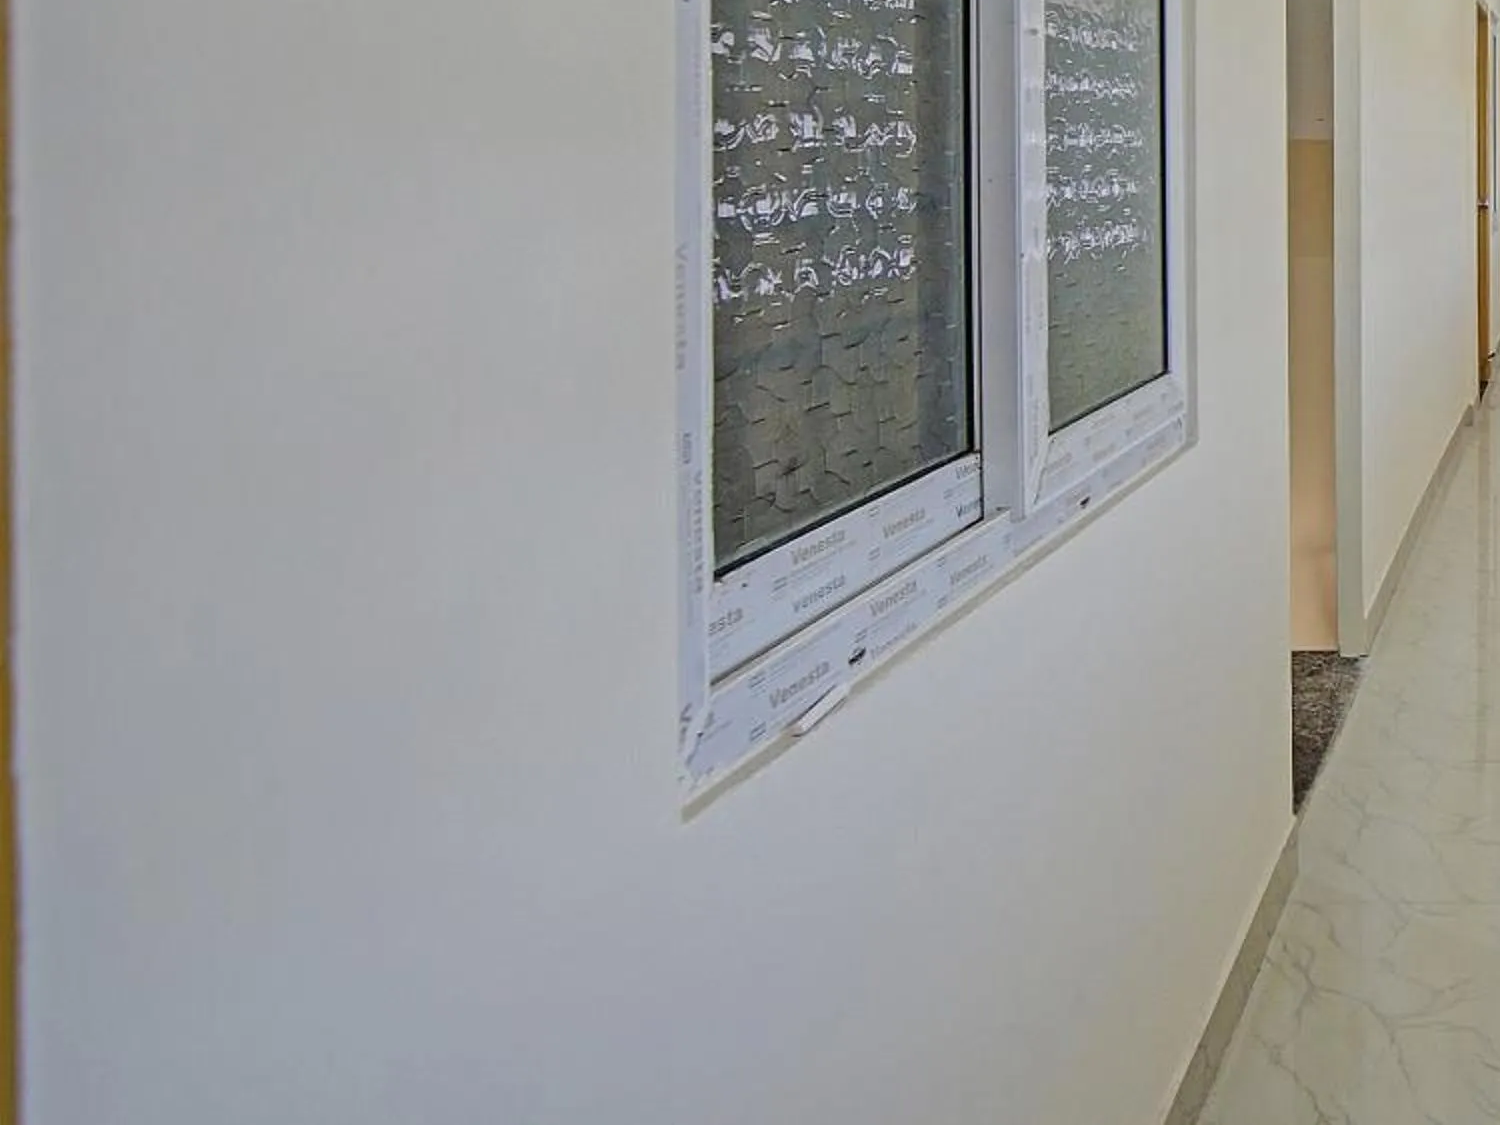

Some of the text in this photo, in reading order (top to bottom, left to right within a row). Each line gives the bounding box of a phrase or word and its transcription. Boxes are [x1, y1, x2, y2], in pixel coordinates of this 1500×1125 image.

[882, 507, 926, 540] Venesta
[790, 530, 846, 565] Venesta
[769, 660, 830, 709] Venesta
